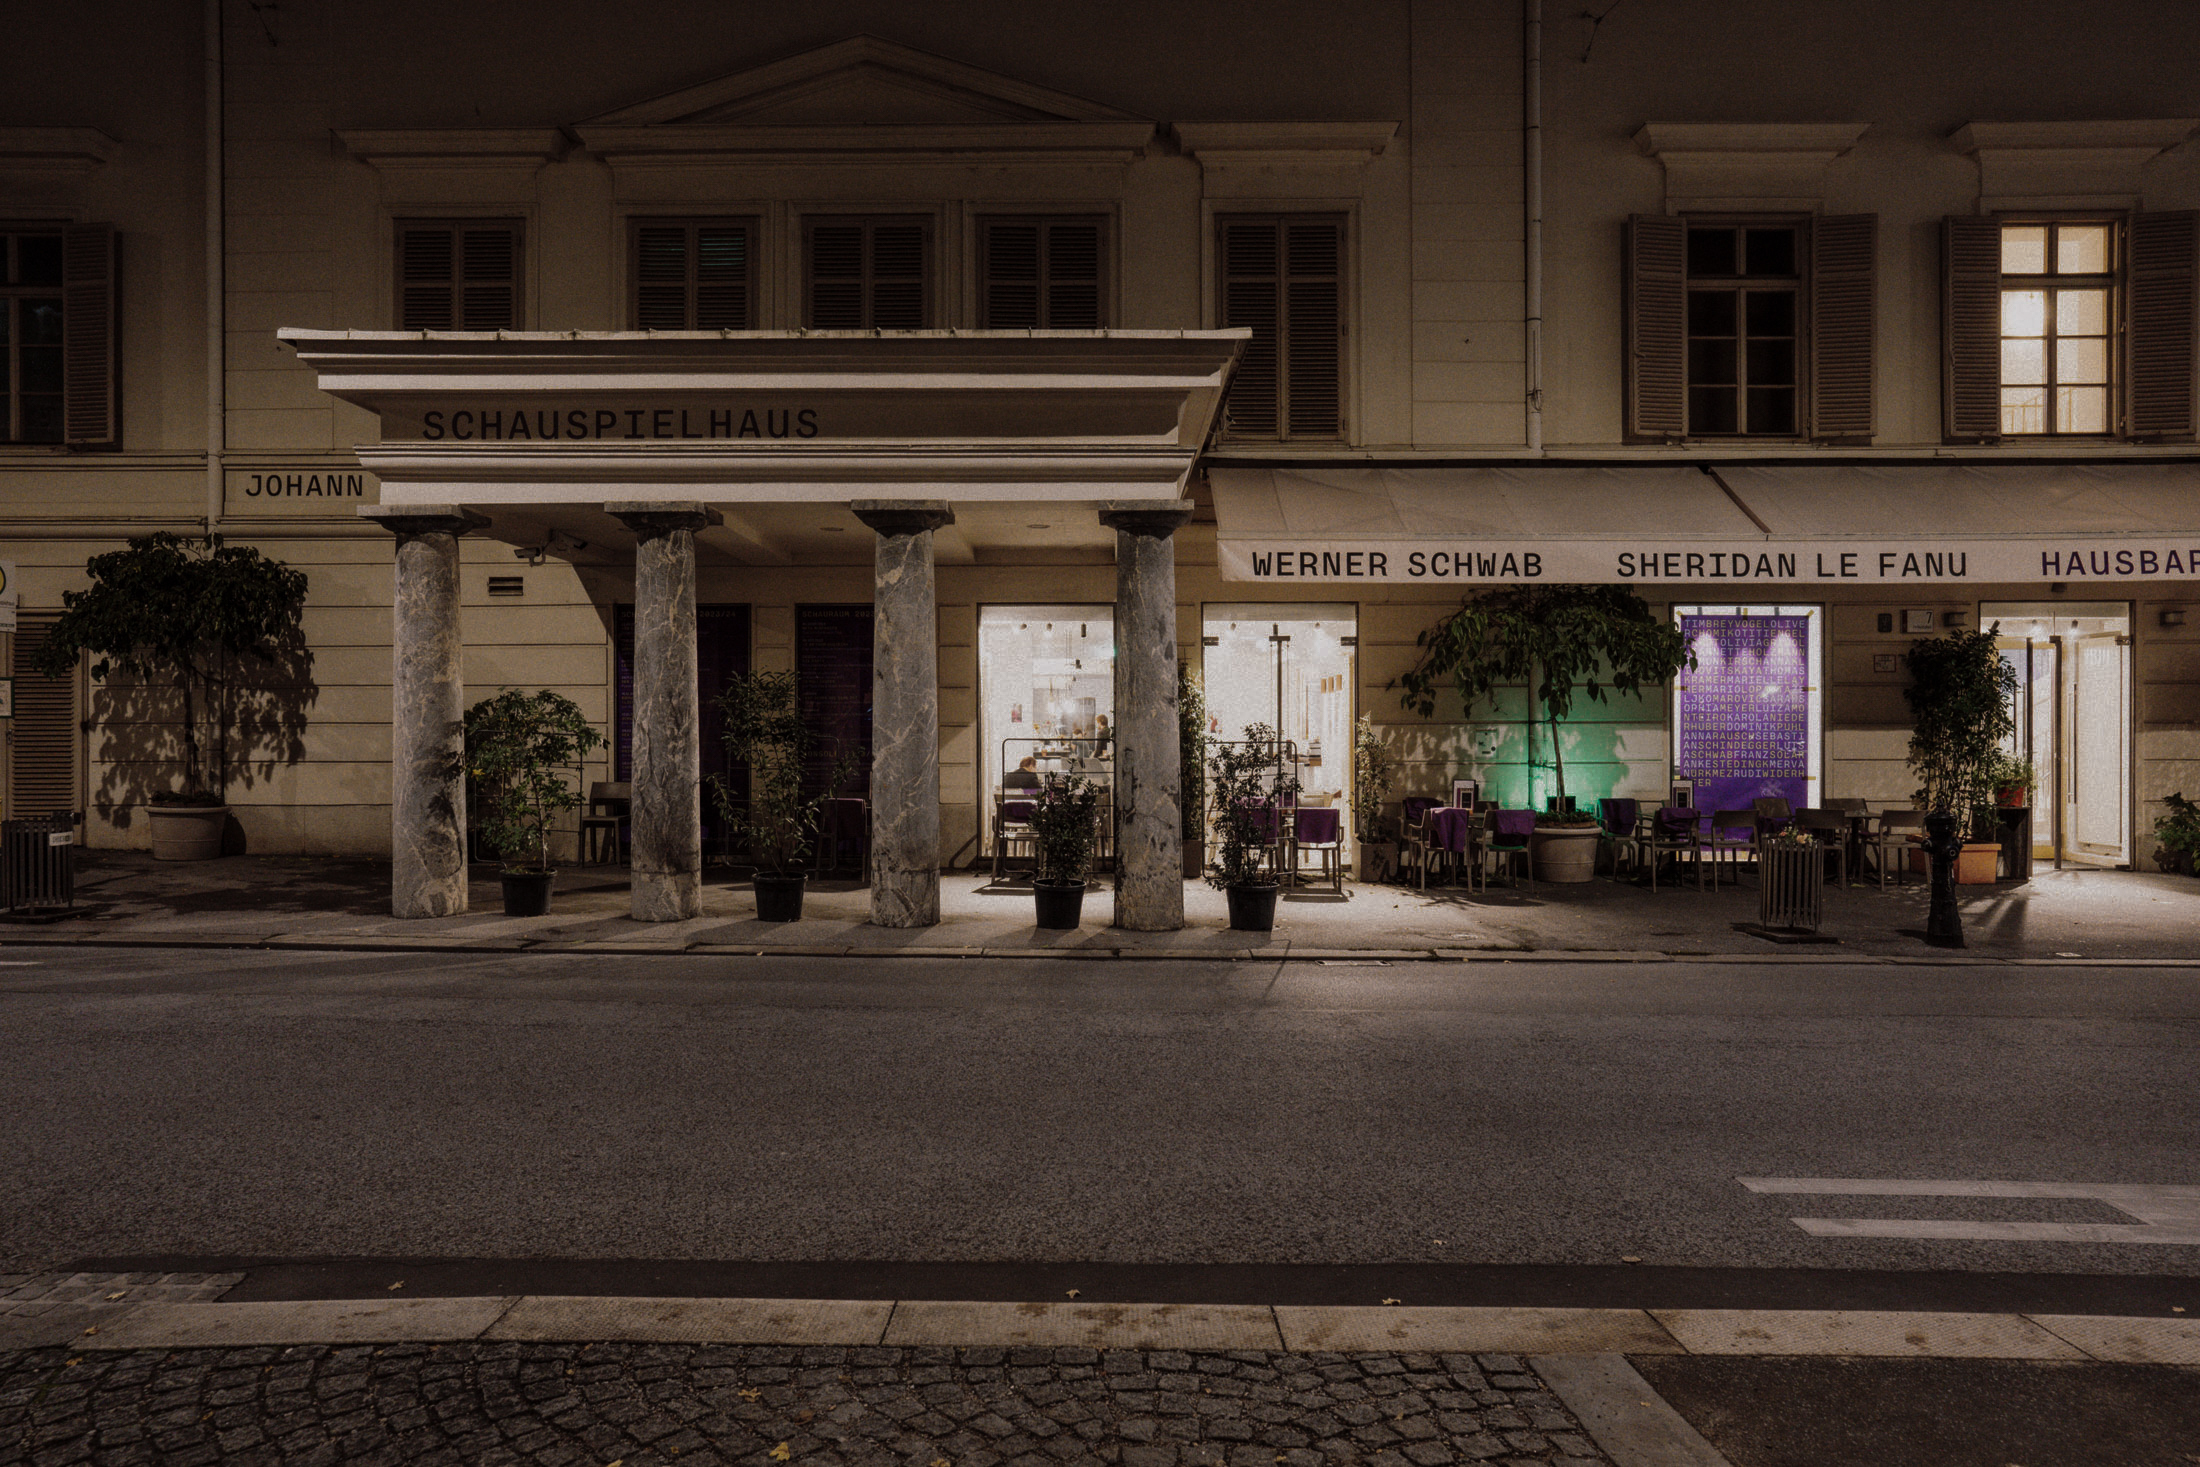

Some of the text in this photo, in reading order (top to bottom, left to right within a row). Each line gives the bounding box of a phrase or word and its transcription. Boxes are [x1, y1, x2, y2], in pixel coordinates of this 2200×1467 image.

[422, 409, 819, 441] SCHAUSPIELHAUS
[245, 474, 363, 497] JOHANN
[1251, 551, 1543, 577] WERNER SCHWAB
[1616, 552, 1968, 578] SHERIDAN LE FANU
[801, 610, 850, 618] SCHAURAUM
[1925, 611, 1933, 624] 7
